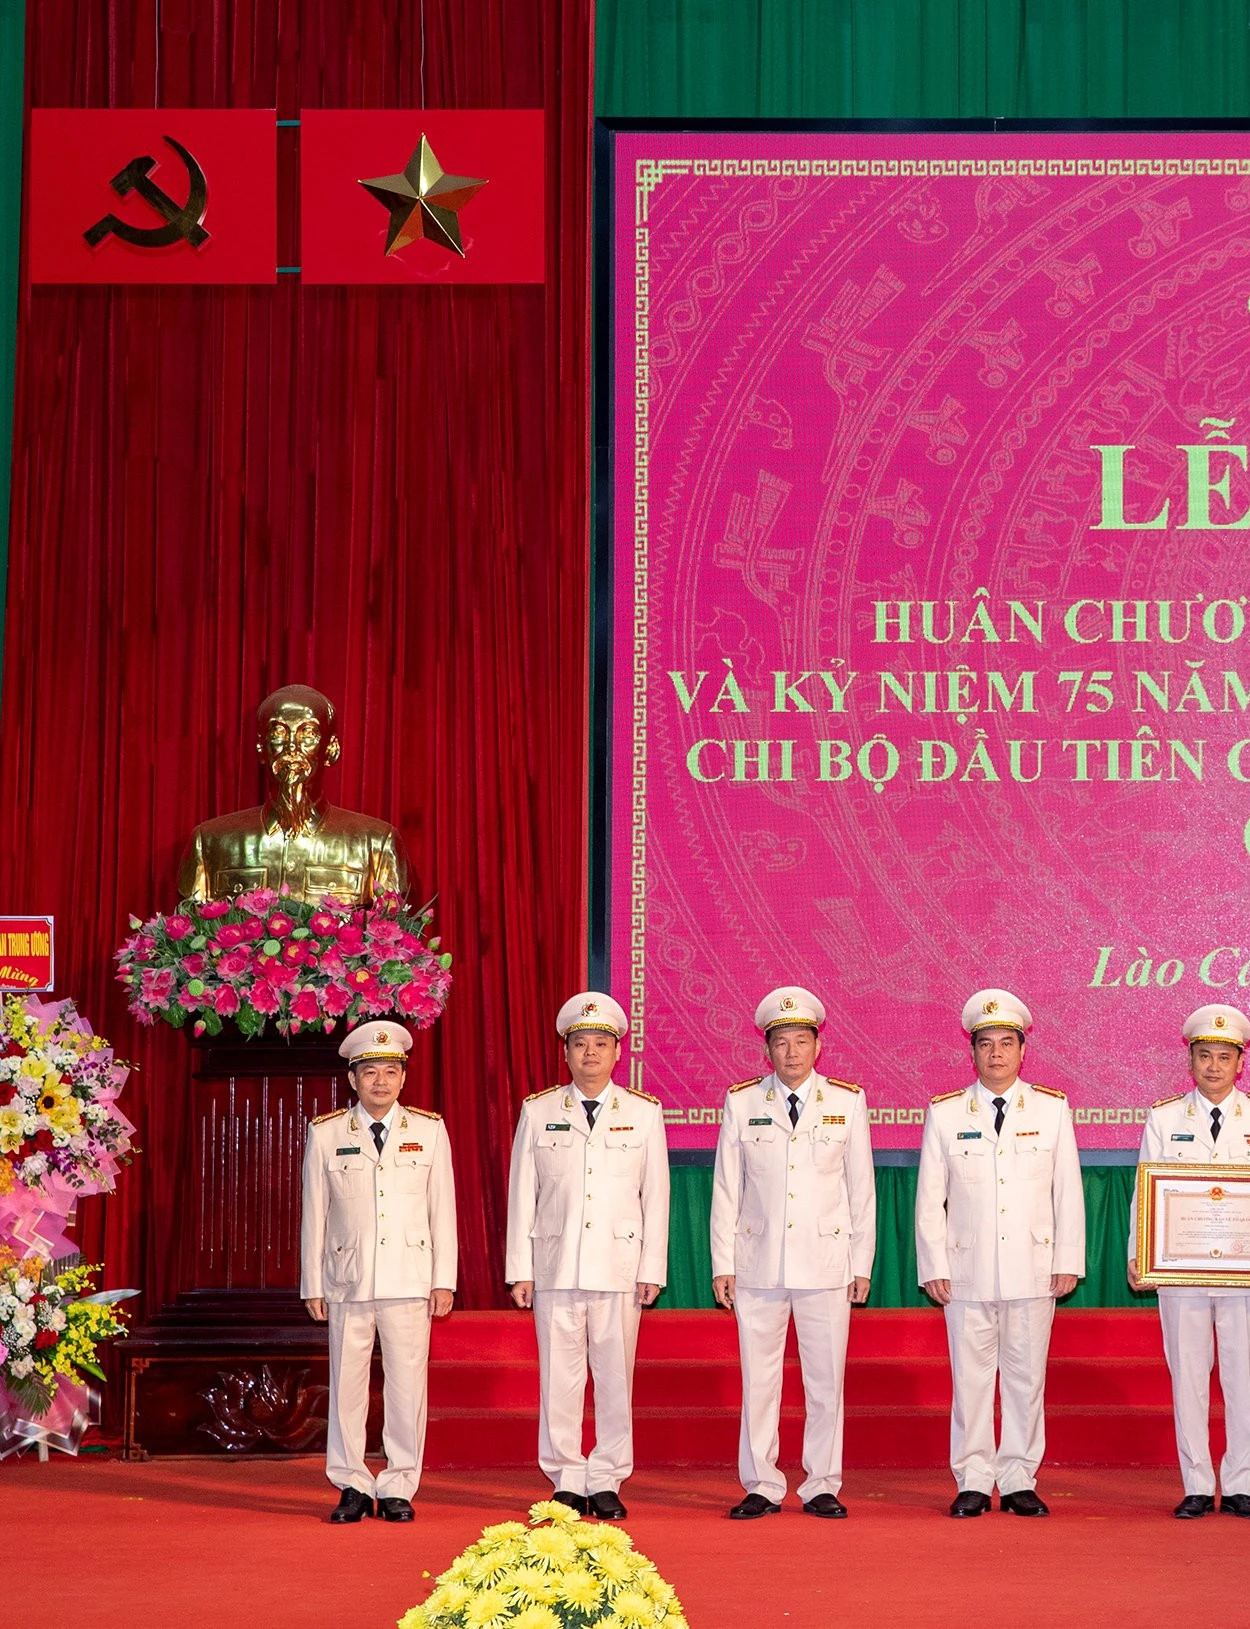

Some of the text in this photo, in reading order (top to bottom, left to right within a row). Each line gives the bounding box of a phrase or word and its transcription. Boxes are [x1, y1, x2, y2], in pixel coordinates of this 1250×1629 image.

[873, 587, 1045, 644] HUÂN
[667, 658, 751, 713] VÀ
[772, 659, 858, 713] KỶ
[878, 664, 1038, 724] NIỆM
[1057, 671, 1115, 713] 75
[685, 739, 795, 783] CHI
[817, 733, 901, 793] BỘ
[916, 727, 1046, 783] ĐẦU
[1061, 725, 1205, 782] TIÊN
[1086, 946, 1186, 988] Lào
